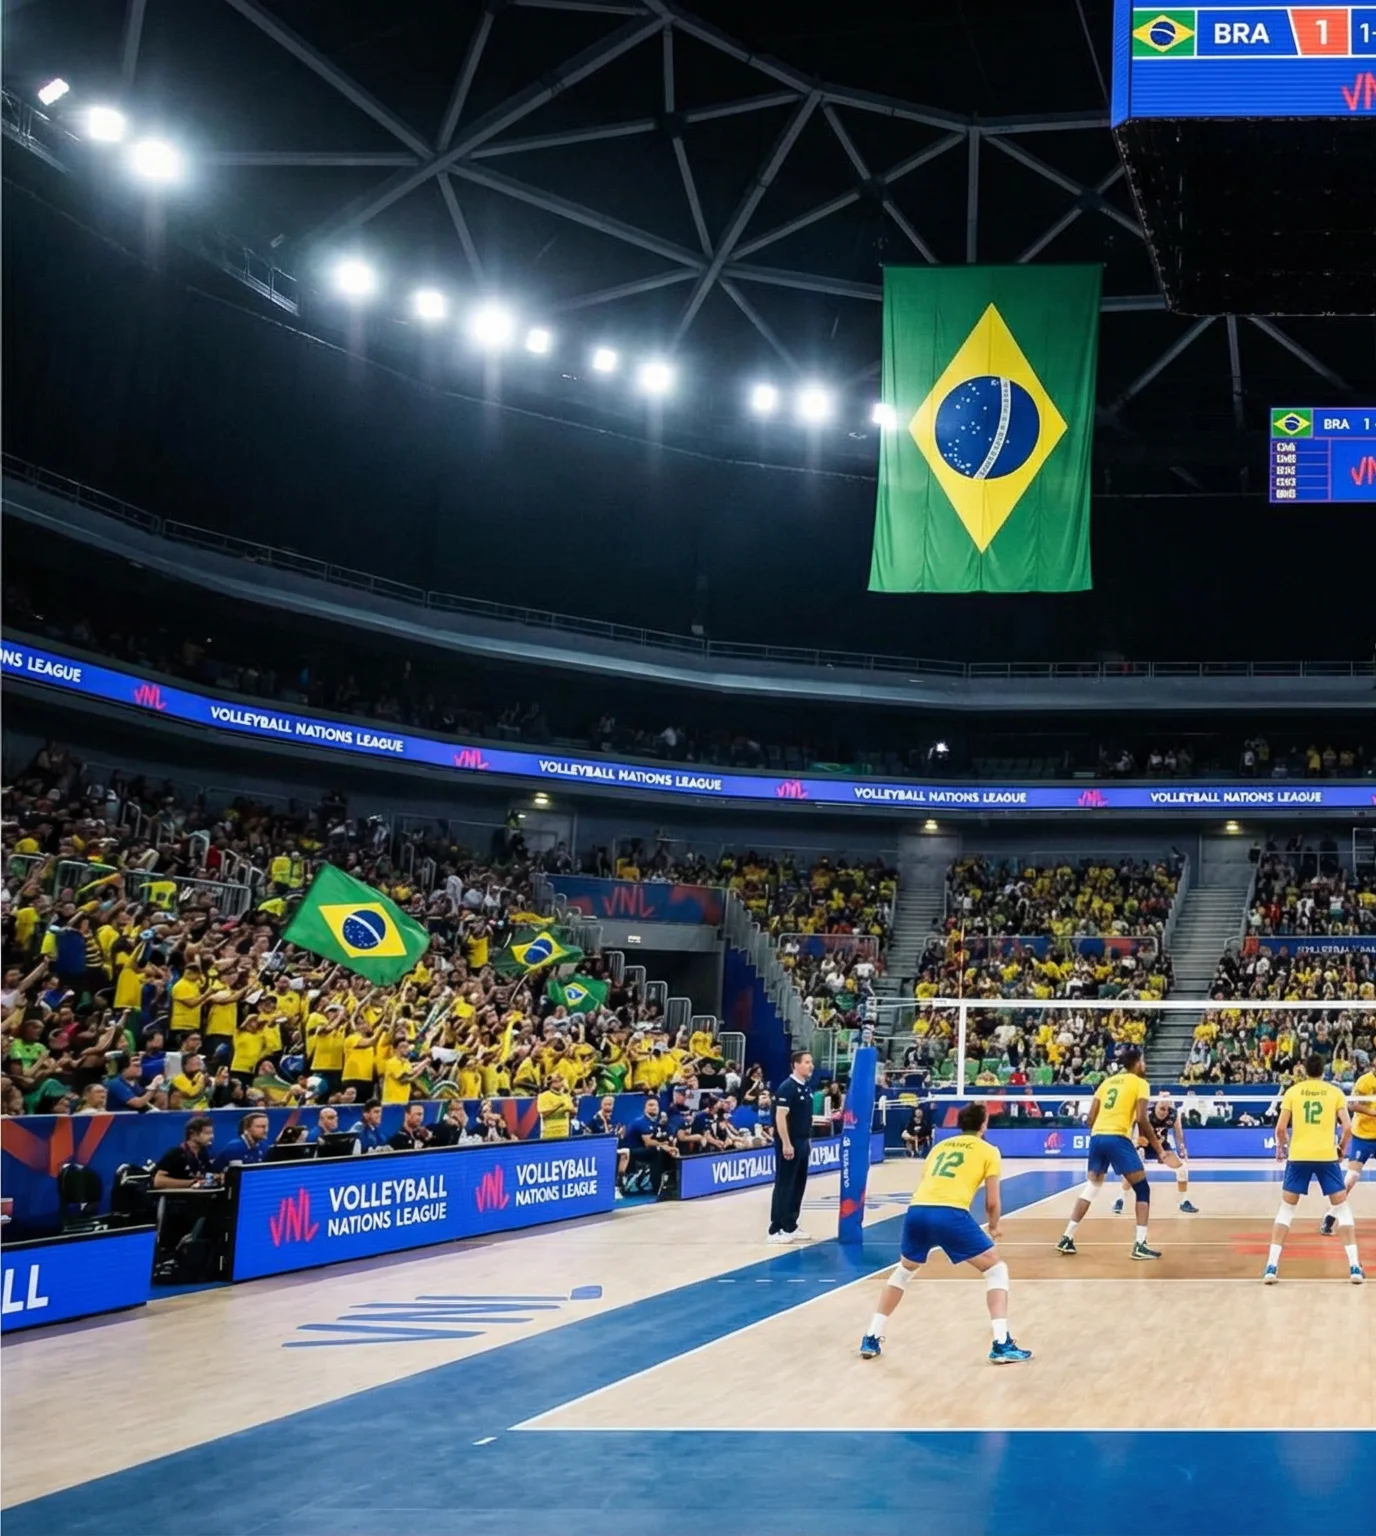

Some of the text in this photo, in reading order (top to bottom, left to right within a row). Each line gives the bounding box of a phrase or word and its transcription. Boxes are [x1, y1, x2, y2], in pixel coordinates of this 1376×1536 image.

[1213, 22, 1270, 45] BRA
[1315, 19, 1329, 45] 1
[1323, 418, 1351, 430] BRA
[0, 648, 82, 683] NS LEAGUE
[210, 706, 404, 753] VOLLEYBALL NATIONS LEAGUE
[1104, 1088, 1119, 1109] 3
[1303, 1100, 1324, 1124] 12
[516, 1157, 598, 1186] VOLLEYBALL
[931, 1151, 965, 1178] 12
[329, 1174, 448, 1213] VOLLEYBALL
[475, 1164, 510, 1213] VNL
[515, 1180, 598, 1207] NATIONS LEAGUE
[270, 1187, 320, 1248] VNL
[328, 1202, 447, 1237] NATIONS LEAGUE
[1, 1264, 49, 1314] LL
